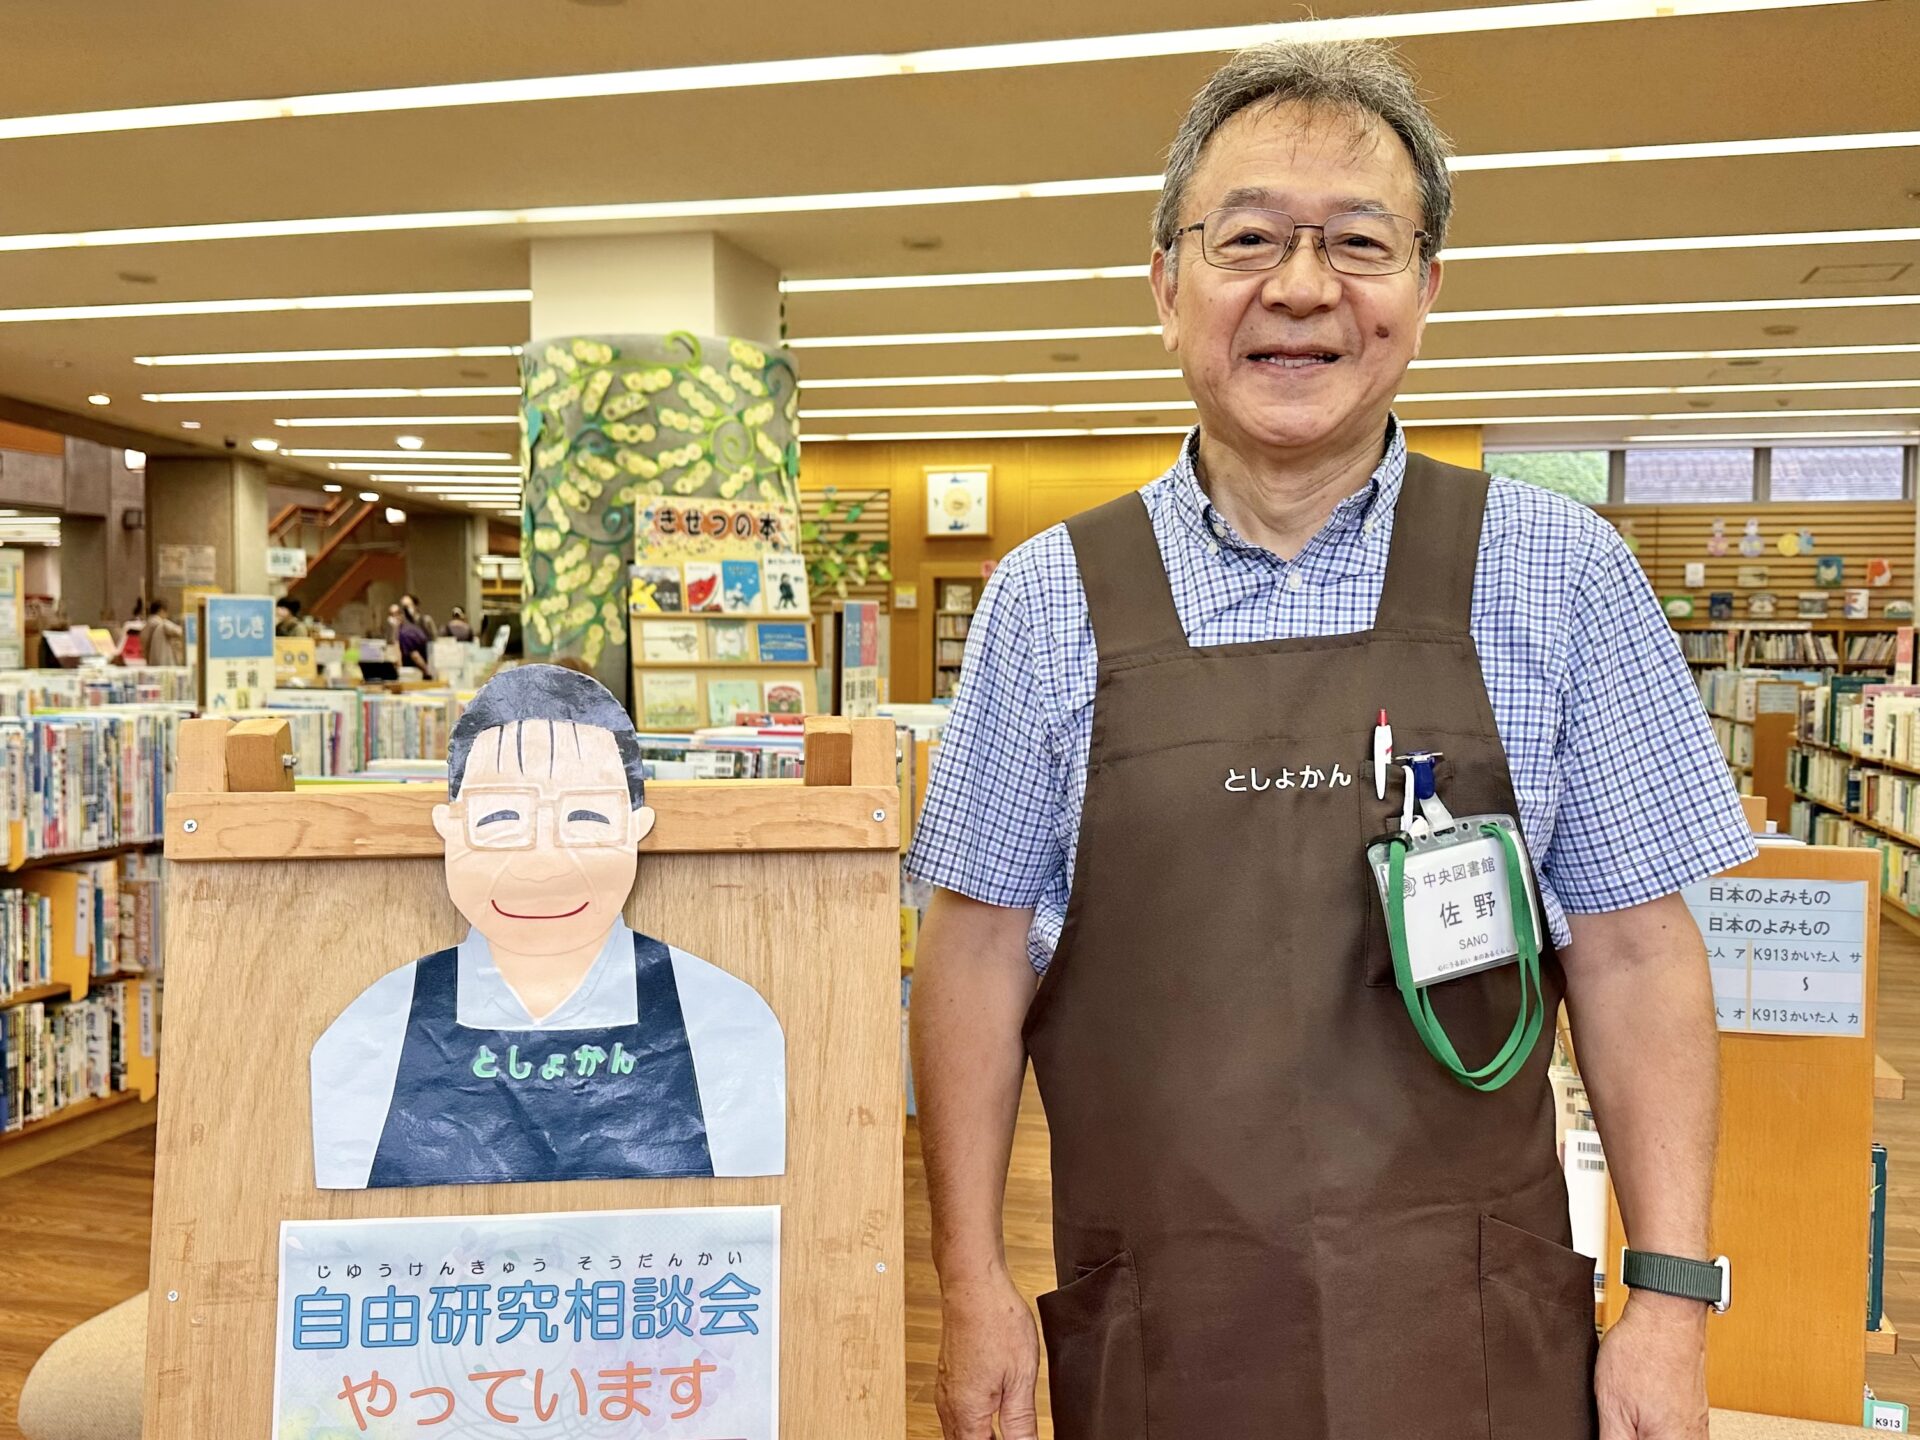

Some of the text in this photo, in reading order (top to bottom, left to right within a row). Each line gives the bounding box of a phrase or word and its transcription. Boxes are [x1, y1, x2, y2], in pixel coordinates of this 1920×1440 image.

[659, 508, 777, 541] きせつの本
[218, 615, 265, 640] ちしき
[1224, 763, 1352, 792] としょかん
[1422, 856, 1496, 888] 中央図書館
[1709, 887, 1831, 906] 日本のよみもの
[1709, 917, 1831, 936] 日本のよみもの
[1458, 933, 1489, 950] SANO
[1734, 948, 1746, 959] ア
[1753, 948, 1863, 964] K913かいた人 サ
[1752, 1008, 1859, 1024] K913かいた人 カ
[471, 1041, 637, 1081] としょかん
[578, 1250, 743, 1271] そうだんかい
[292, 1271, 762, 1351] 自由研究相談会
[338, 1358, 718, 1431] やっています
[1875, 1417, 1901, 1429] K913
